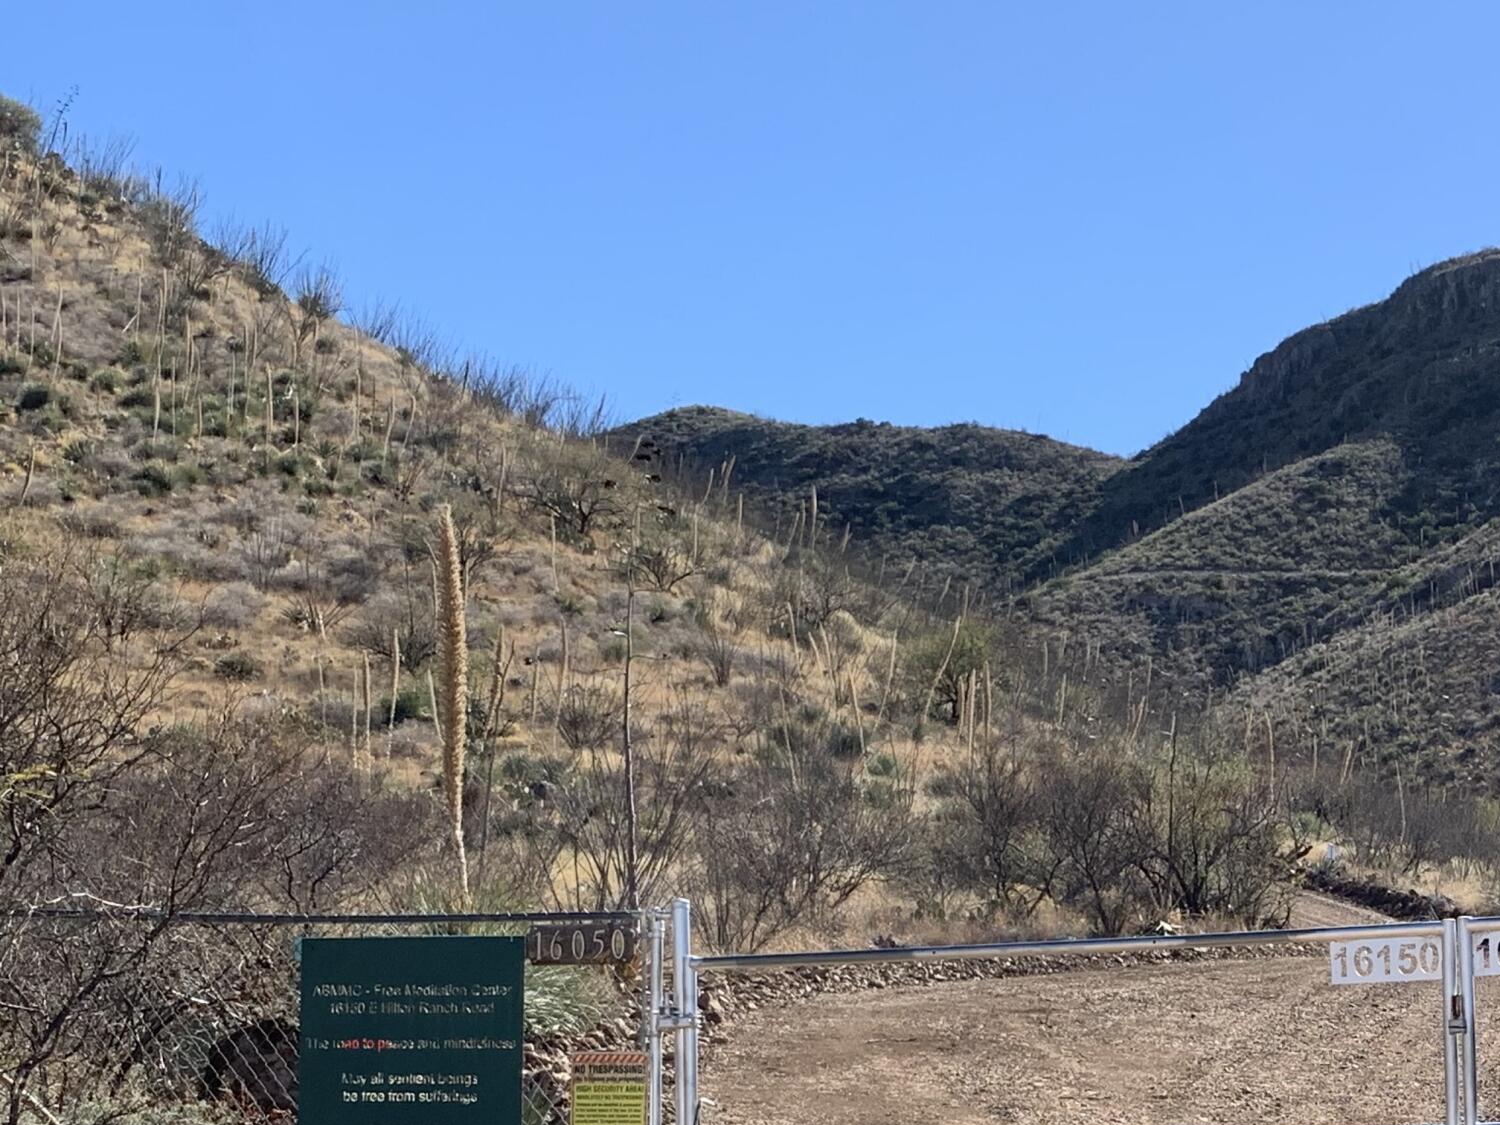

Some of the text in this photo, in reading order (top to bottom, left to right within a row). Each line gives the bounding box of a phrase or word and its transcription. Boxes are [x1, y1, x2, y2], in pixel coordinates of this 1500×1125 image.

[533, 928, 626, 961] 16050
[1334, 942, 1439, 978] 16150
[374, 984, 402, 997] Free
[470, 983, 512, 996] Center
[419, 1001, 459, 1014] Ranch
[305, 1037, 330, 1050] The
[362, 1038, 376, 1050] to
[377, 1039, 415, 1053] peace
[417, 1038, 440, 1050] and
[574, 1064, 586, 1074] NO
[342, 1090, 358, 1102] be
[361, 1091, 385, 1102] free
[387, 1091, 416, 1102] from
